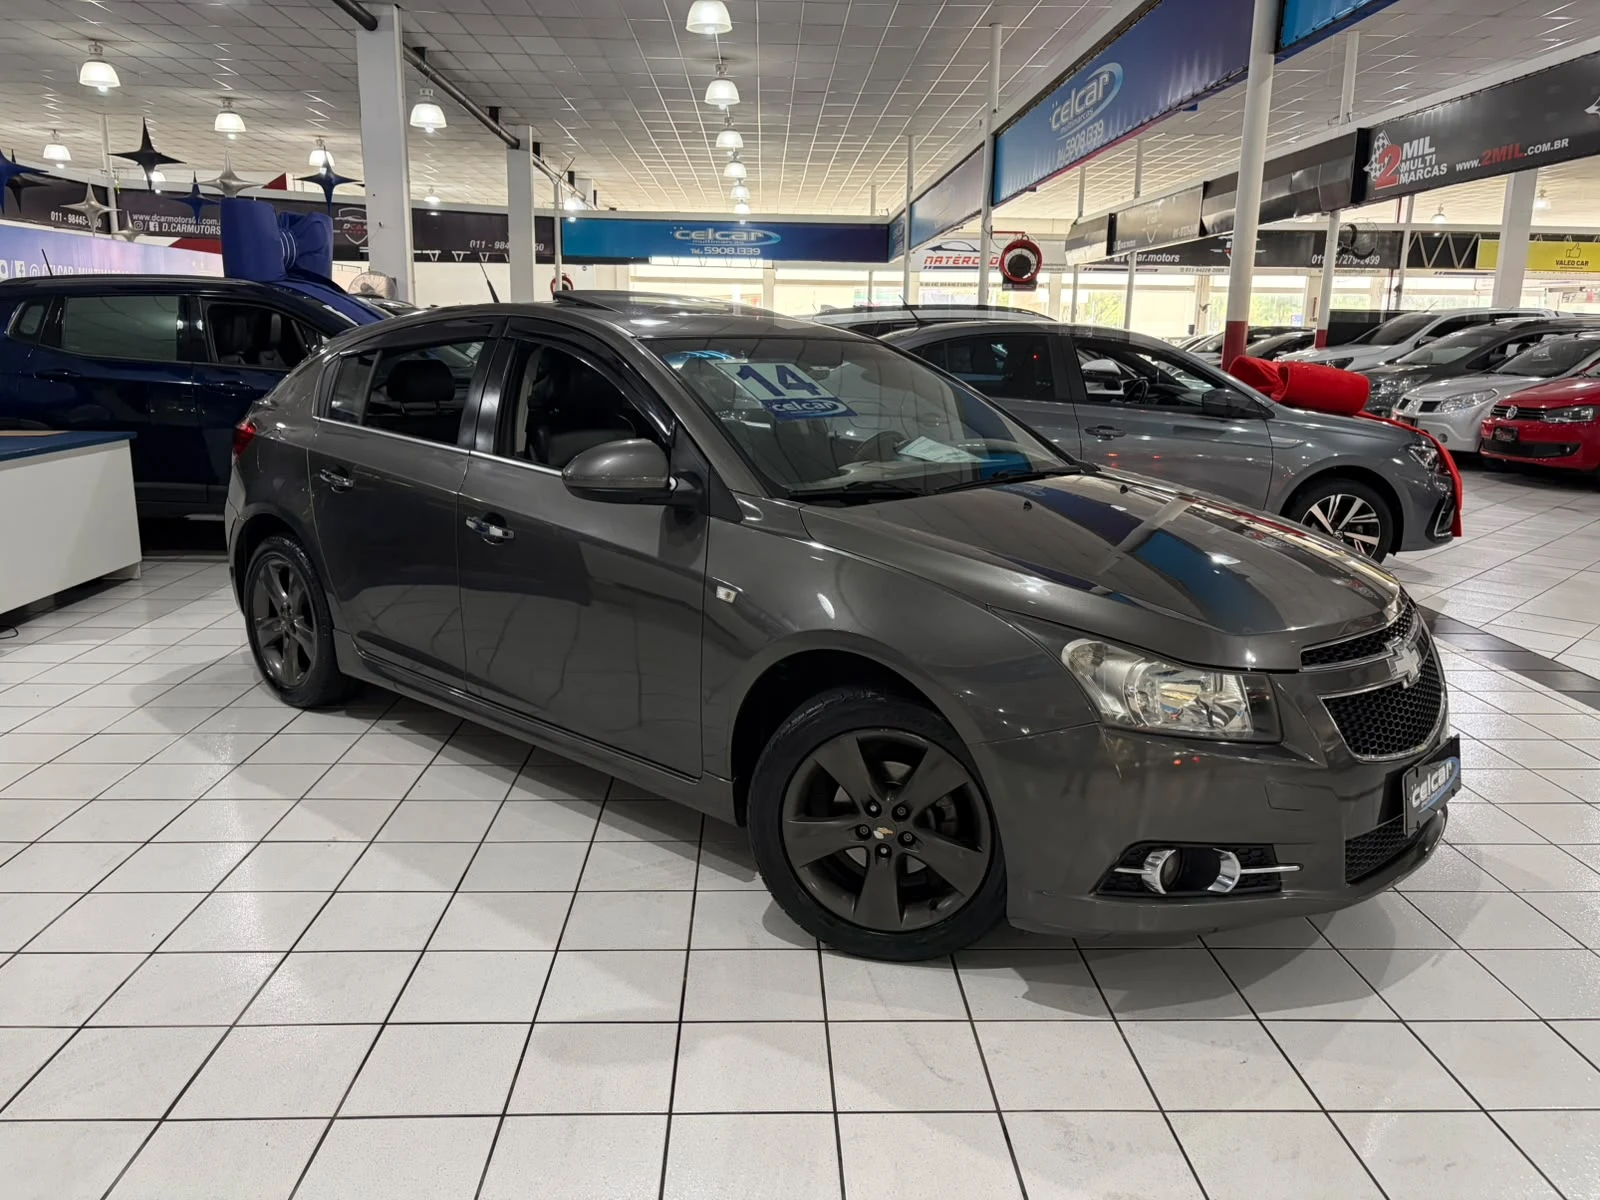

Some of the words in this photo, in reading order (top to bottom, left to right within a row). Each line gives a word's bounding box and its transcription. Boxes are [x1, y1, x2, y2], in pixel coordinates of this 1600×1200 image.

[1051, 72, 1109, 132] celcar
[1402, 136, 1435, 160] MIL
[1400, 154, 1436, 173] MULTI
[1399, 163, 1448, 185] MARCAS
[50, 211, 63, 222] 011
[469, 240, 486, 249] 011
[674, 228, 764, 241] celcar
[736, 364, 822, 398] 14
[771, 400, 834, 413] celcar
[1411, 759, 1453, 808] celcar
